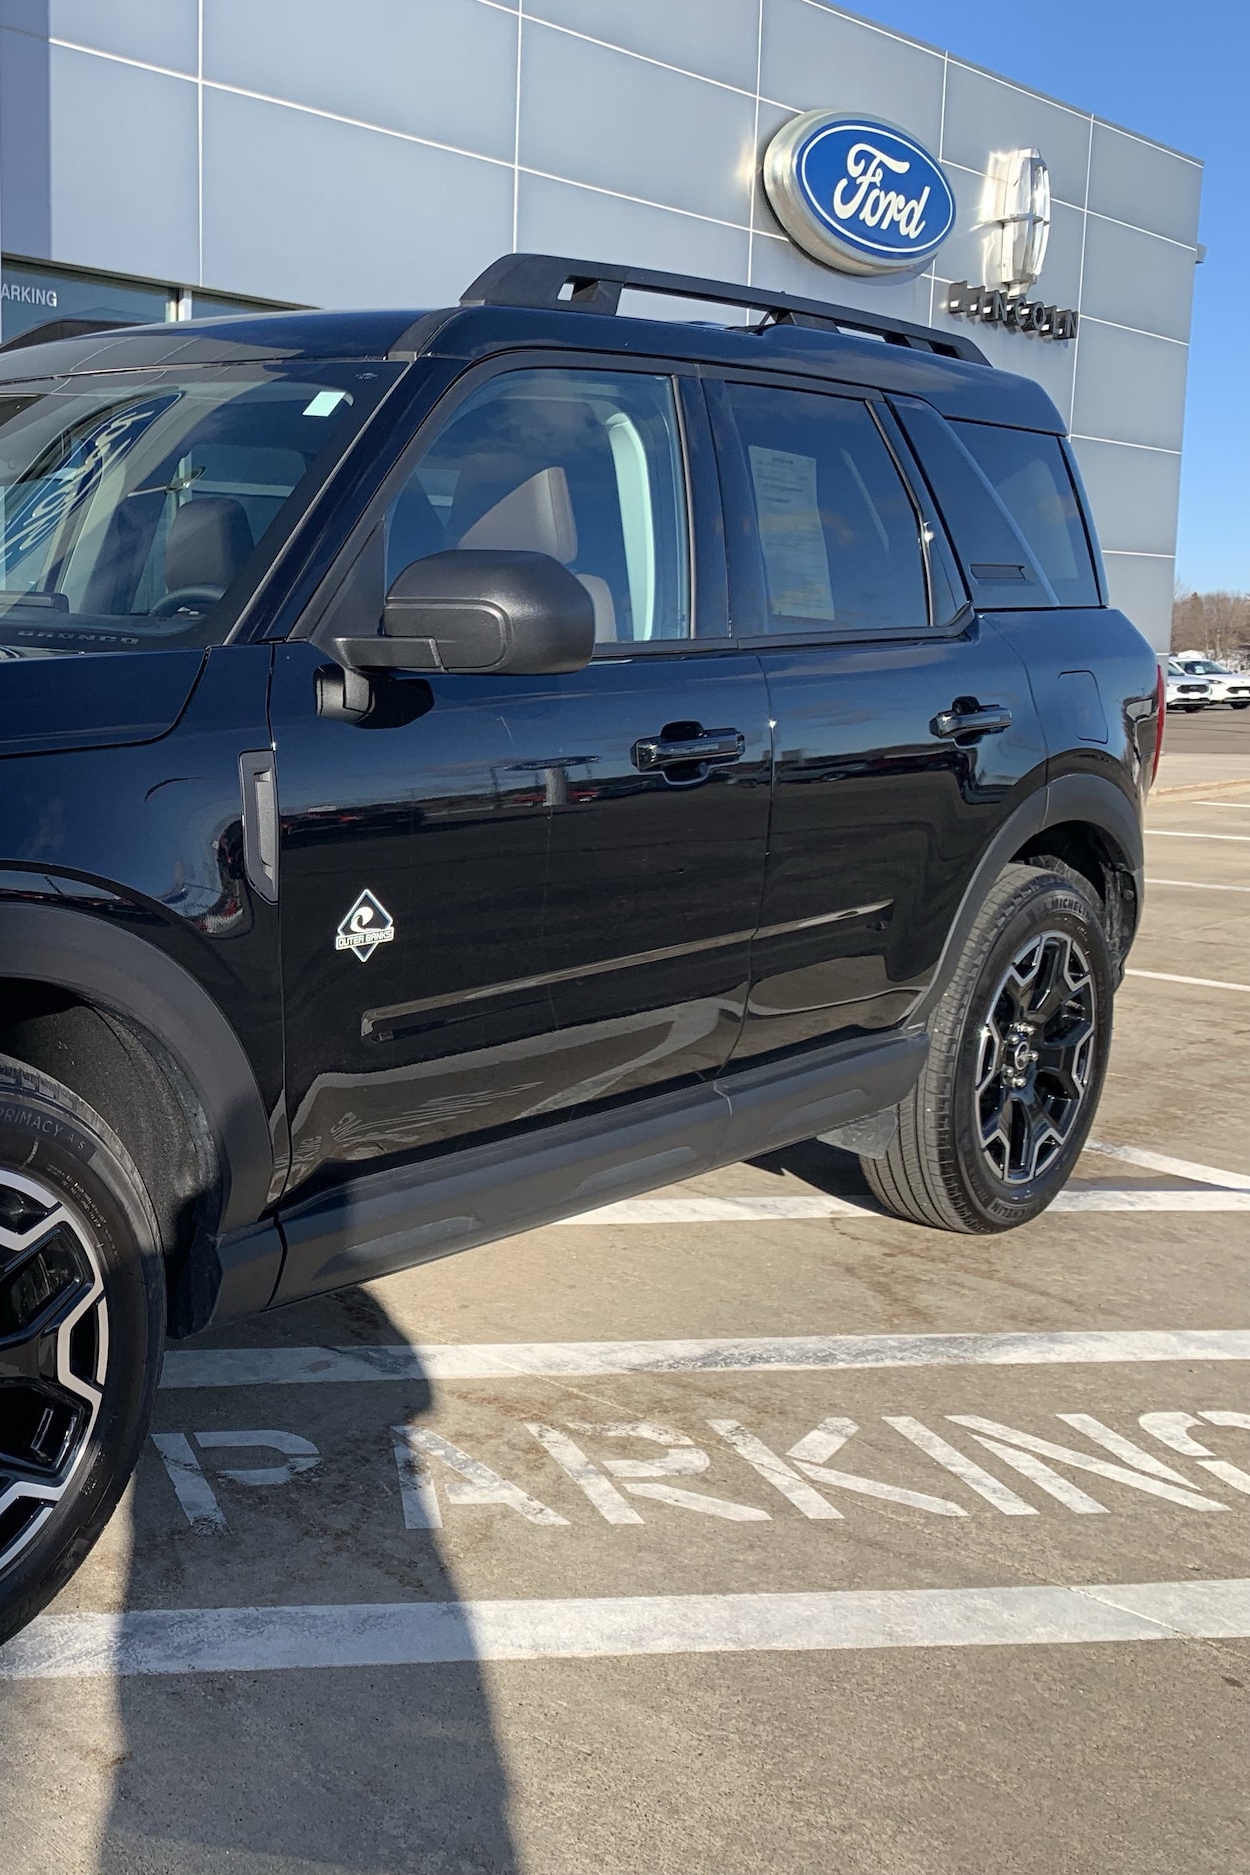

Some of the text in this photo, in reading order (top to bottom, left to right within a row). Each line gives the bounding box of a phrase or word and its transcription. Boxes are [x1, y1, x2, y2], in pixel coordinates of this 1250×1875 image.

[833, 143, 931, 239] Ford
[1, 283, 57, 308] ARKING
[949, 281, 1079, 340] LINCOLN
[338, 930, 392, 947] OUTER BANKS
